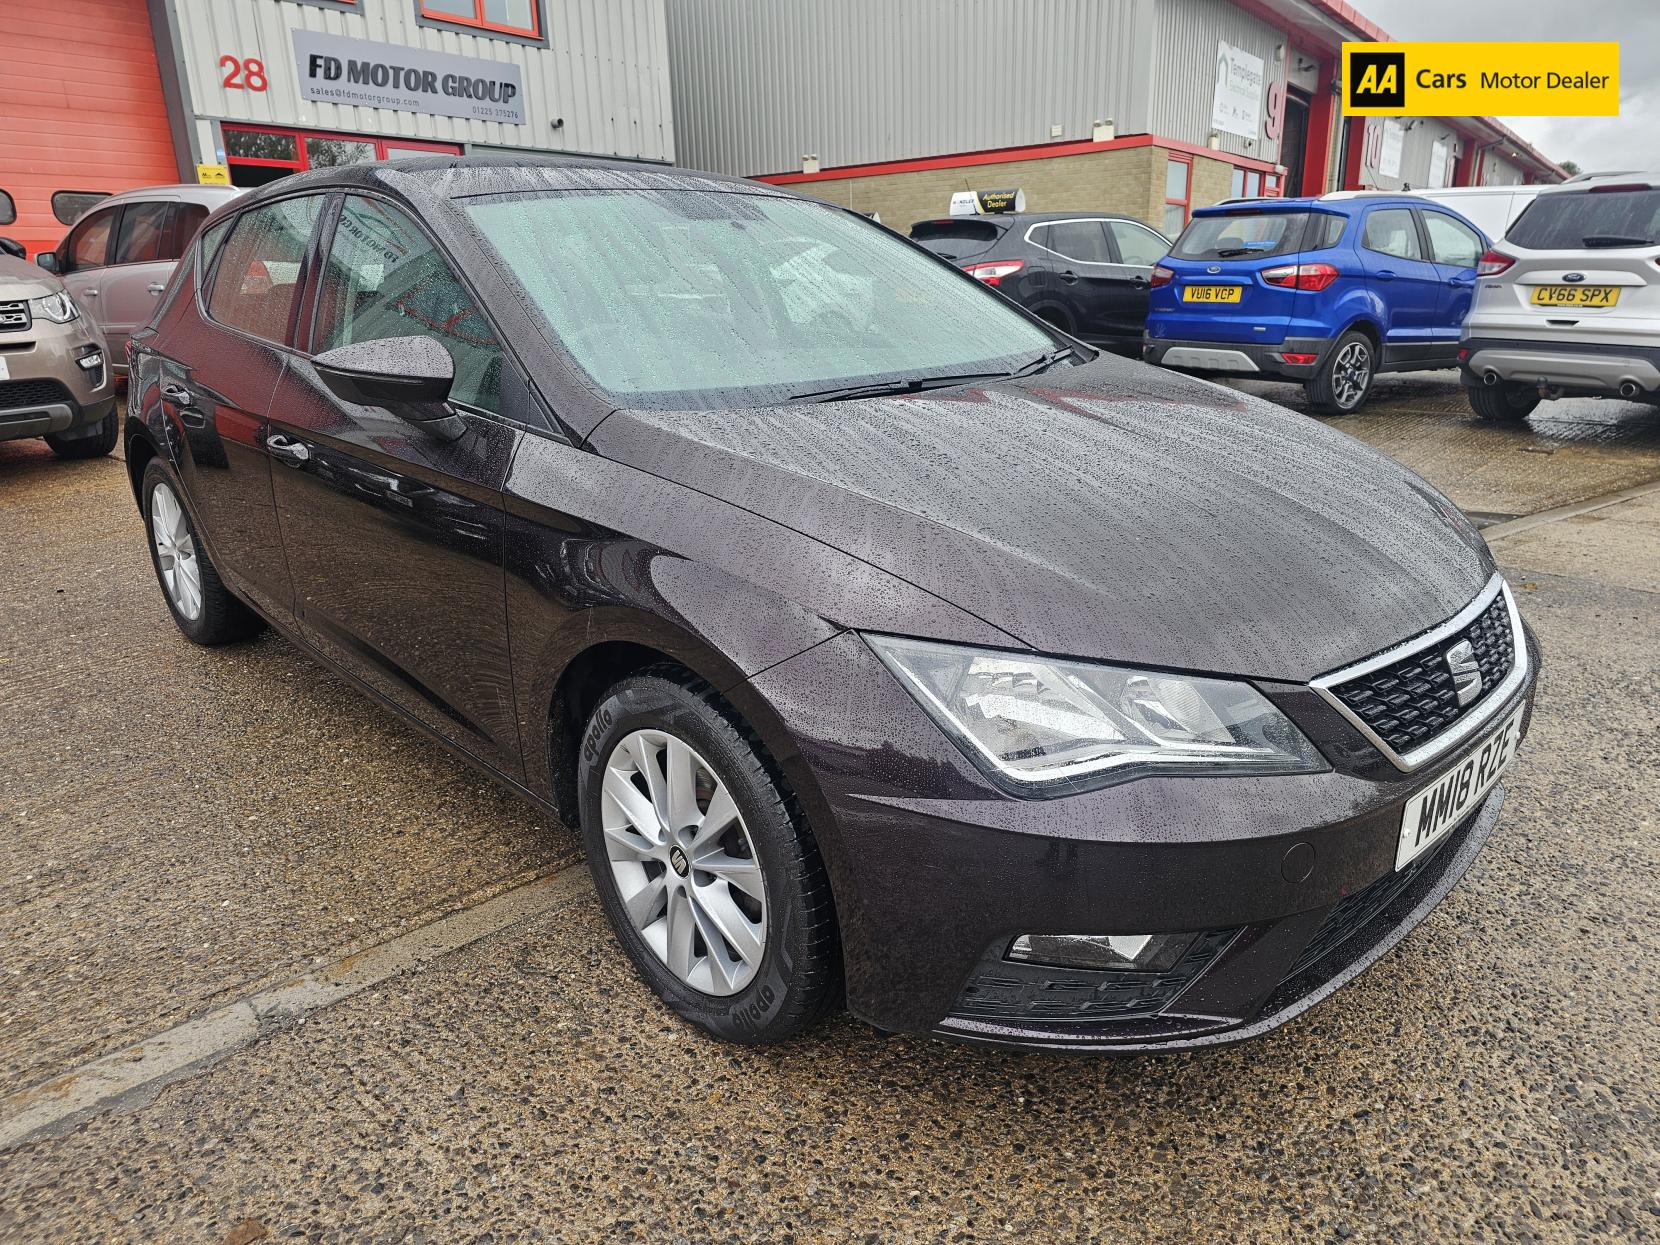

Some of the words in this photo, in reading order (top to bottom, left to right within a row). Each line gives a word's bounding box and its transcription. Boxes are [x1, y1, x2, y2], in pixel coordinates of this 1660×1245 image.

[219, 54, 268, 92] 28
[308, 53, 343, 81] FD
[346, 60, 438, 94] MOTOR
[441, 73, 517, 104] GROUP
[1264, 81, 1282, 140] 9
[1365, 123, 1381, 168] 10
[982, 191, 1015, 201] Authorised
[987, 200, 1007, 208] Dealer
[1191, 287, 1211, 300] VU16
[1214, 288, 1235, 300] VCP
[1537, 287, 1575, 302] CV66
[1579, 288, 1613, 303] SPX
[583, 705, 613, 762] apollo
[1414, 758, 1475, 849] MM18
[1473, 718, 1515, 795] RZE
